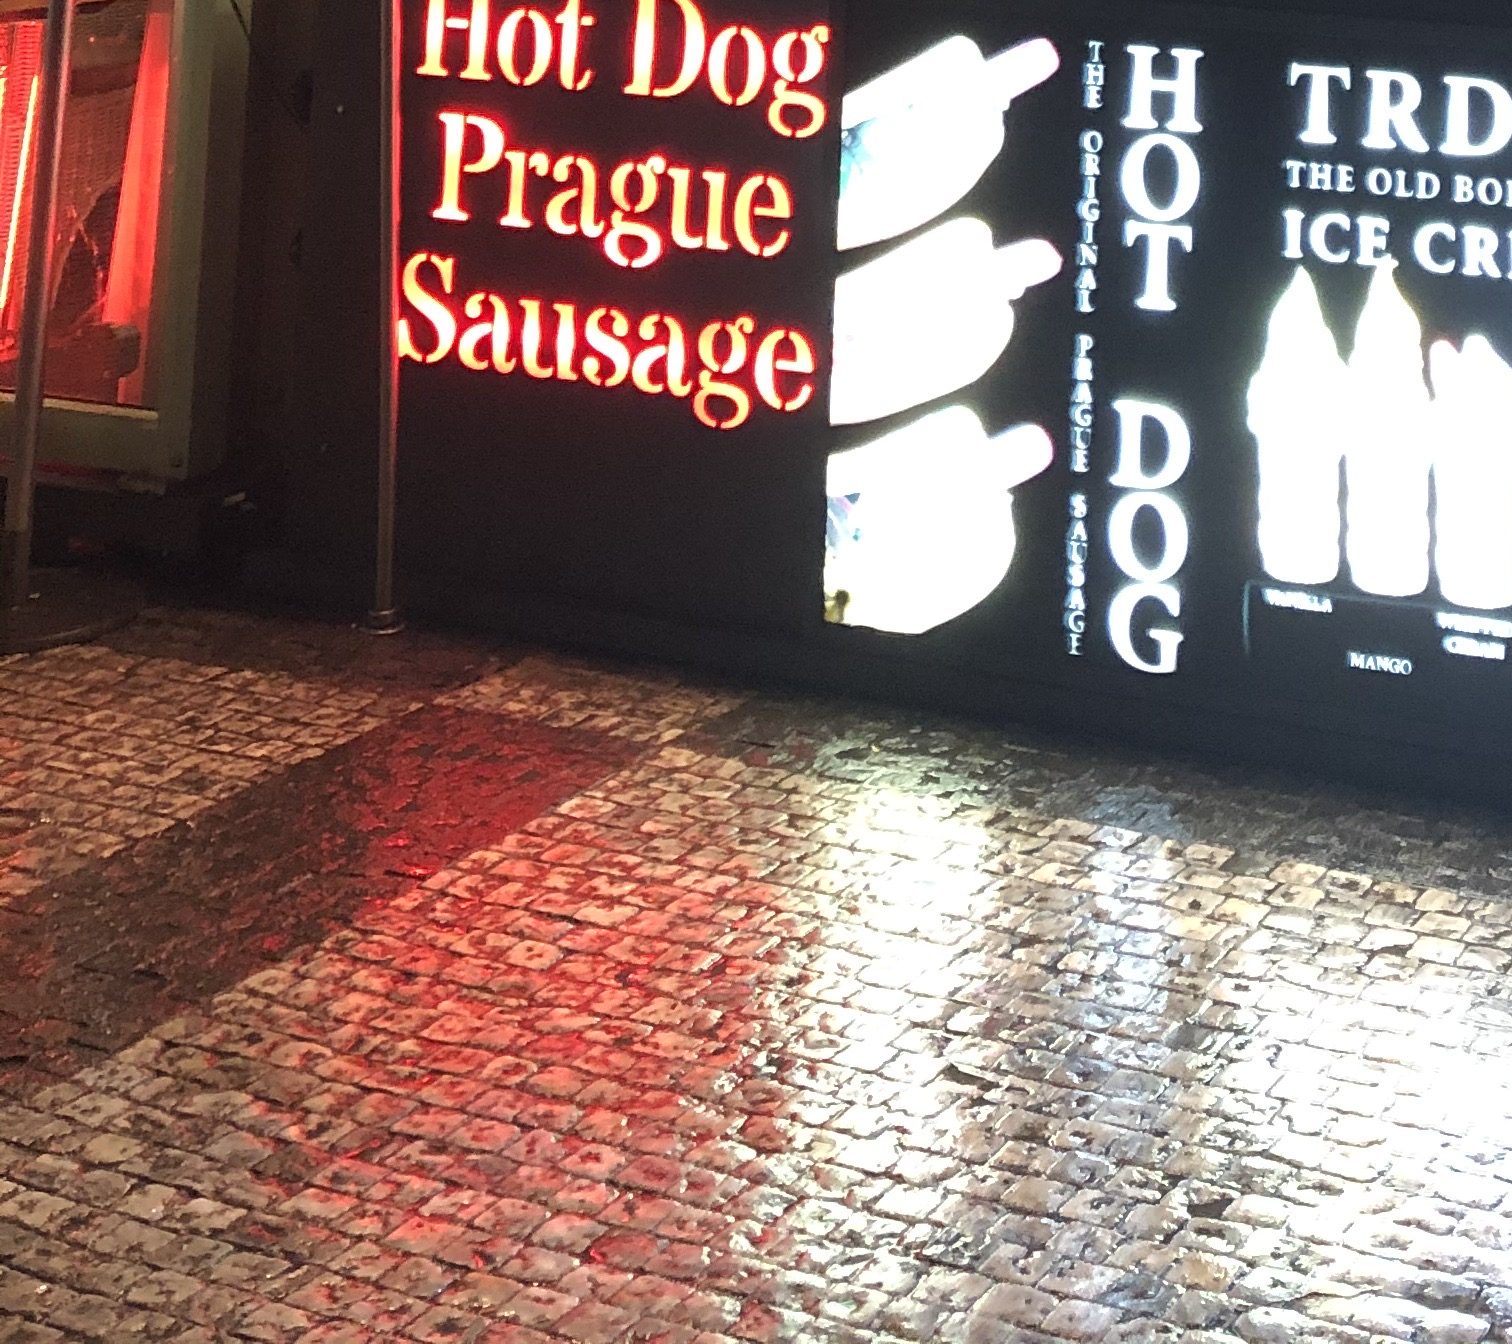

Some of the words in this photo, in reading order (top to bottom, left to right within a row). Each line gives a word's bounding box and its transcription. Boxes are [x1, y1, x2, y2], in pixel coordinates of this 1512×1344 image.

[1083, 40, 1104, 109] THE
[431, 110, 793, 269] Prague
[1075, 130, 1104, 314] ORIGINAL
[1119, 43, 1205, 312] HOT
[1281, 208, 1399, 268] ICE
[1285, 159, 1356, 193] THE
[1365, 167, 1442, 200] OLD
[398, 252, 815, 430] Sausage
[1069, 333, 1095, 474] PRAGUE
[1062, 493, 1088, 657] SAUSAGE
[1108, 398, 1192, 674] DOG
[1348, 649, 1412, 676] MANGO
